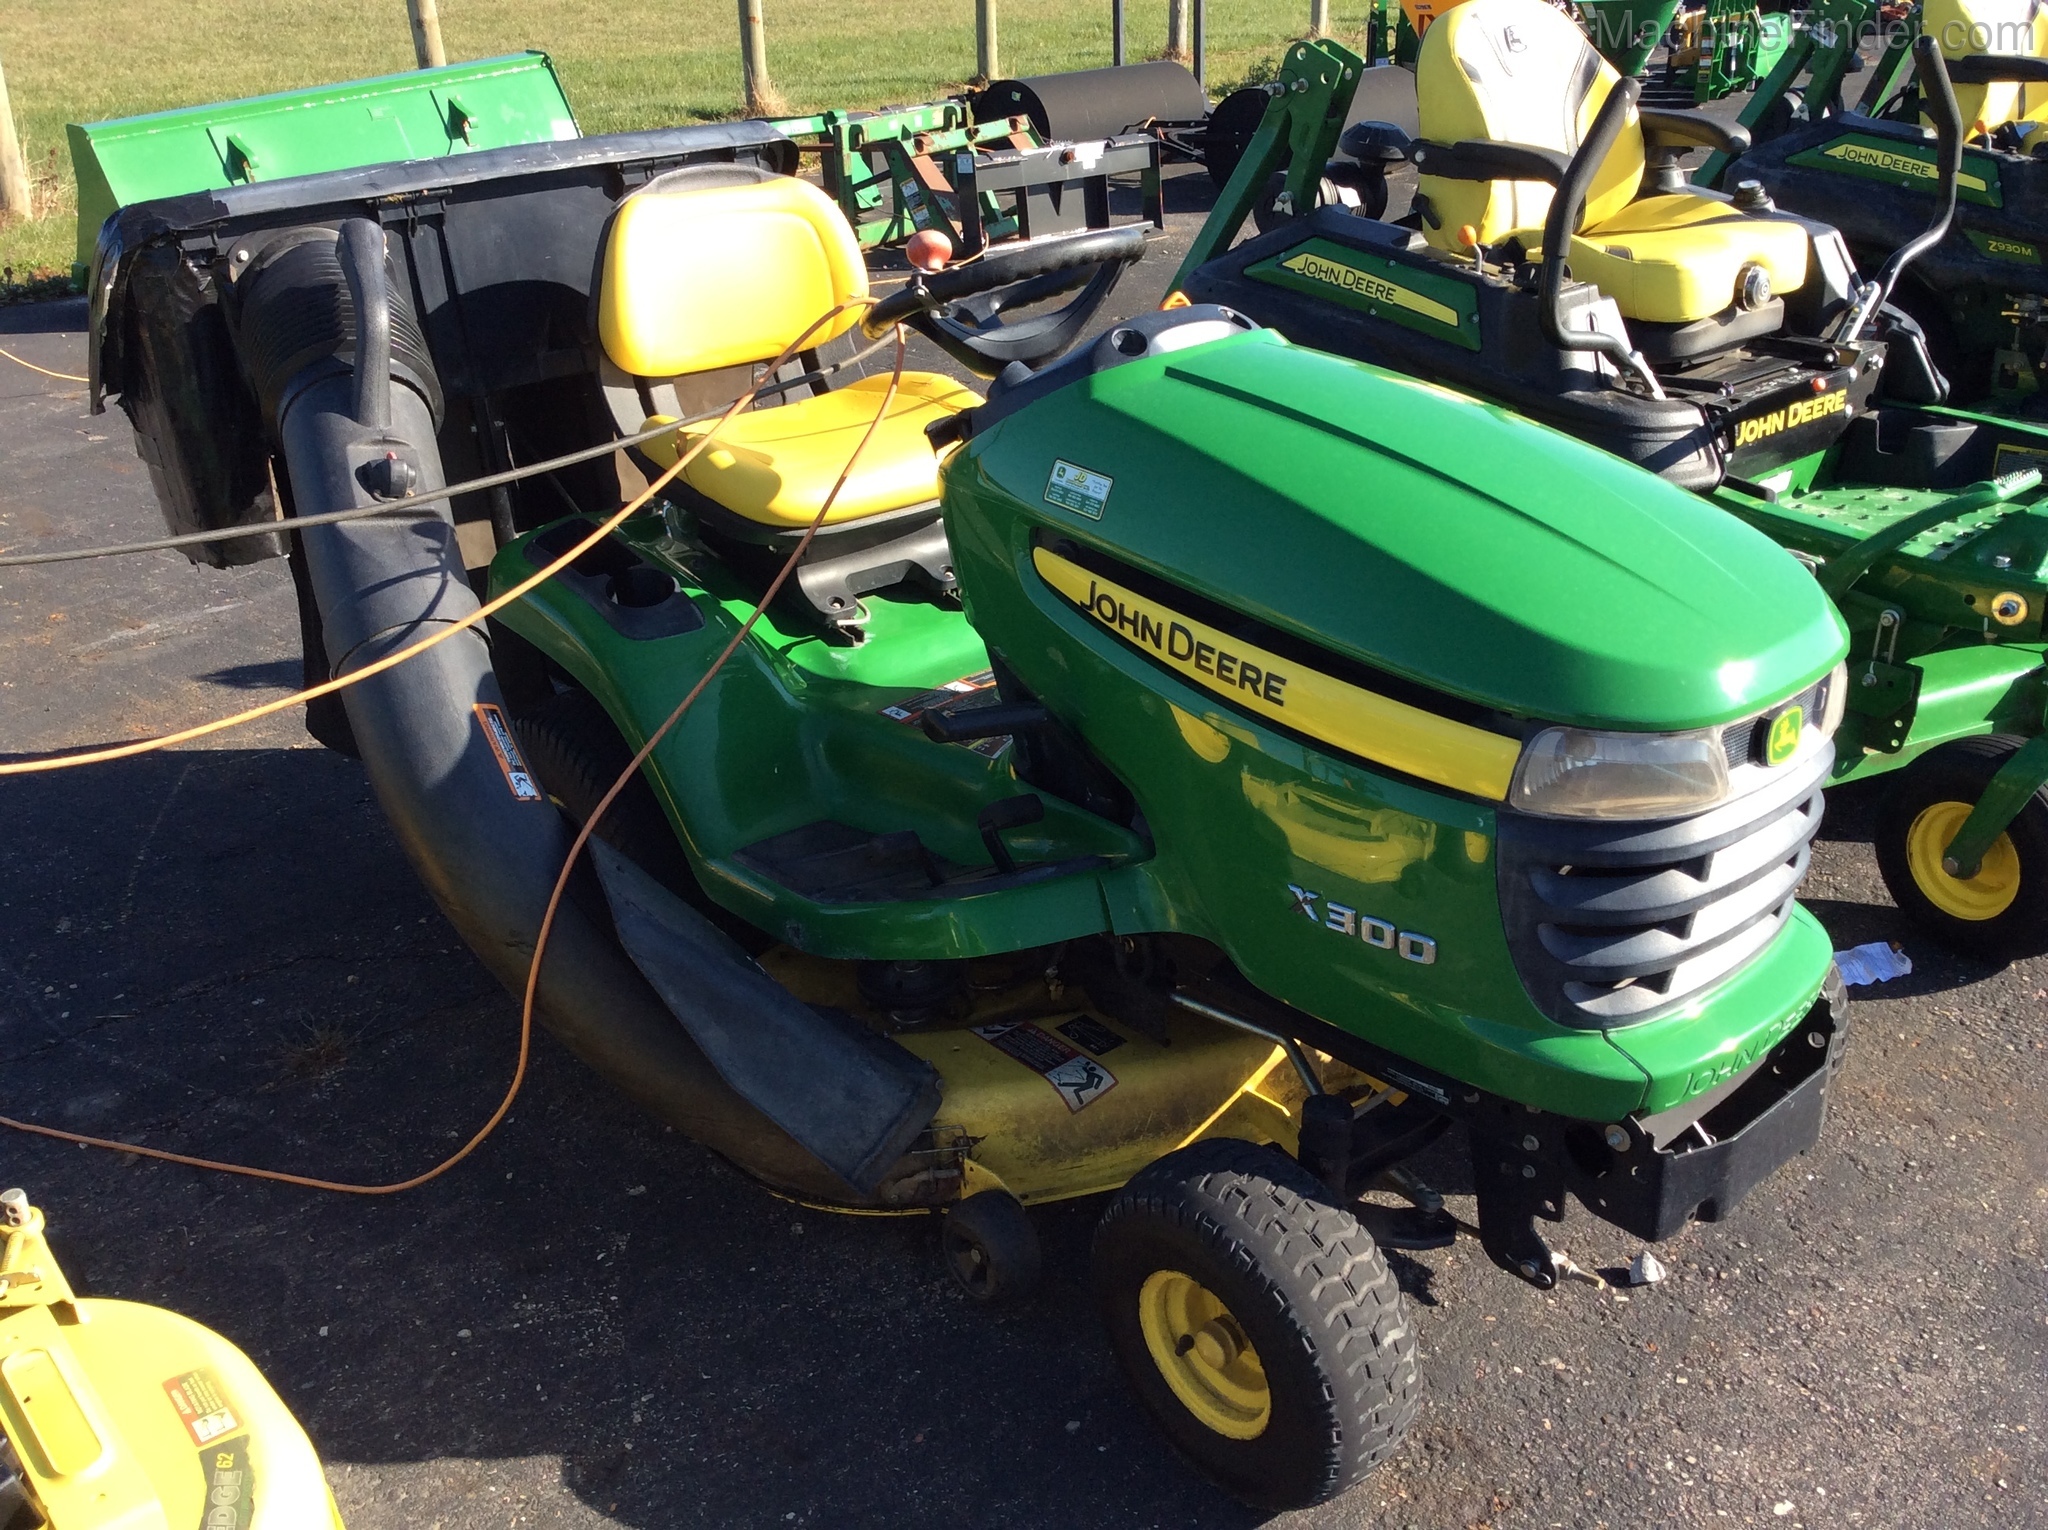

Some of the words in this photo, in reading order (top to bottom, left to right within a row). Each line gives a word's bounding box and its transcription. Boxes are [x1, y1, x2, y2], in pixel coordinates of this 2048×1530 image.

[1838, 147, 1879, 165] JOHN
[1881, 154, 1931, 177] DEERE
[1988, 240, 2032, 256] Z930M
[1297, 257, 1341, 284] JOHN
[1343, 270, 1397, 302] DEERE
[1735, 410, 1785, 447] JOHN
[1787, 389, 1847, 428] DEERE
[1080, 580, 1163, 650] JOHN
[1168, 621, 1287, 707] DEERE
[1287, 883, 1437, 965] X300
[1665, 1041, 1759, 1108] JOHN
[216, 1452, 234, 1469] 62
